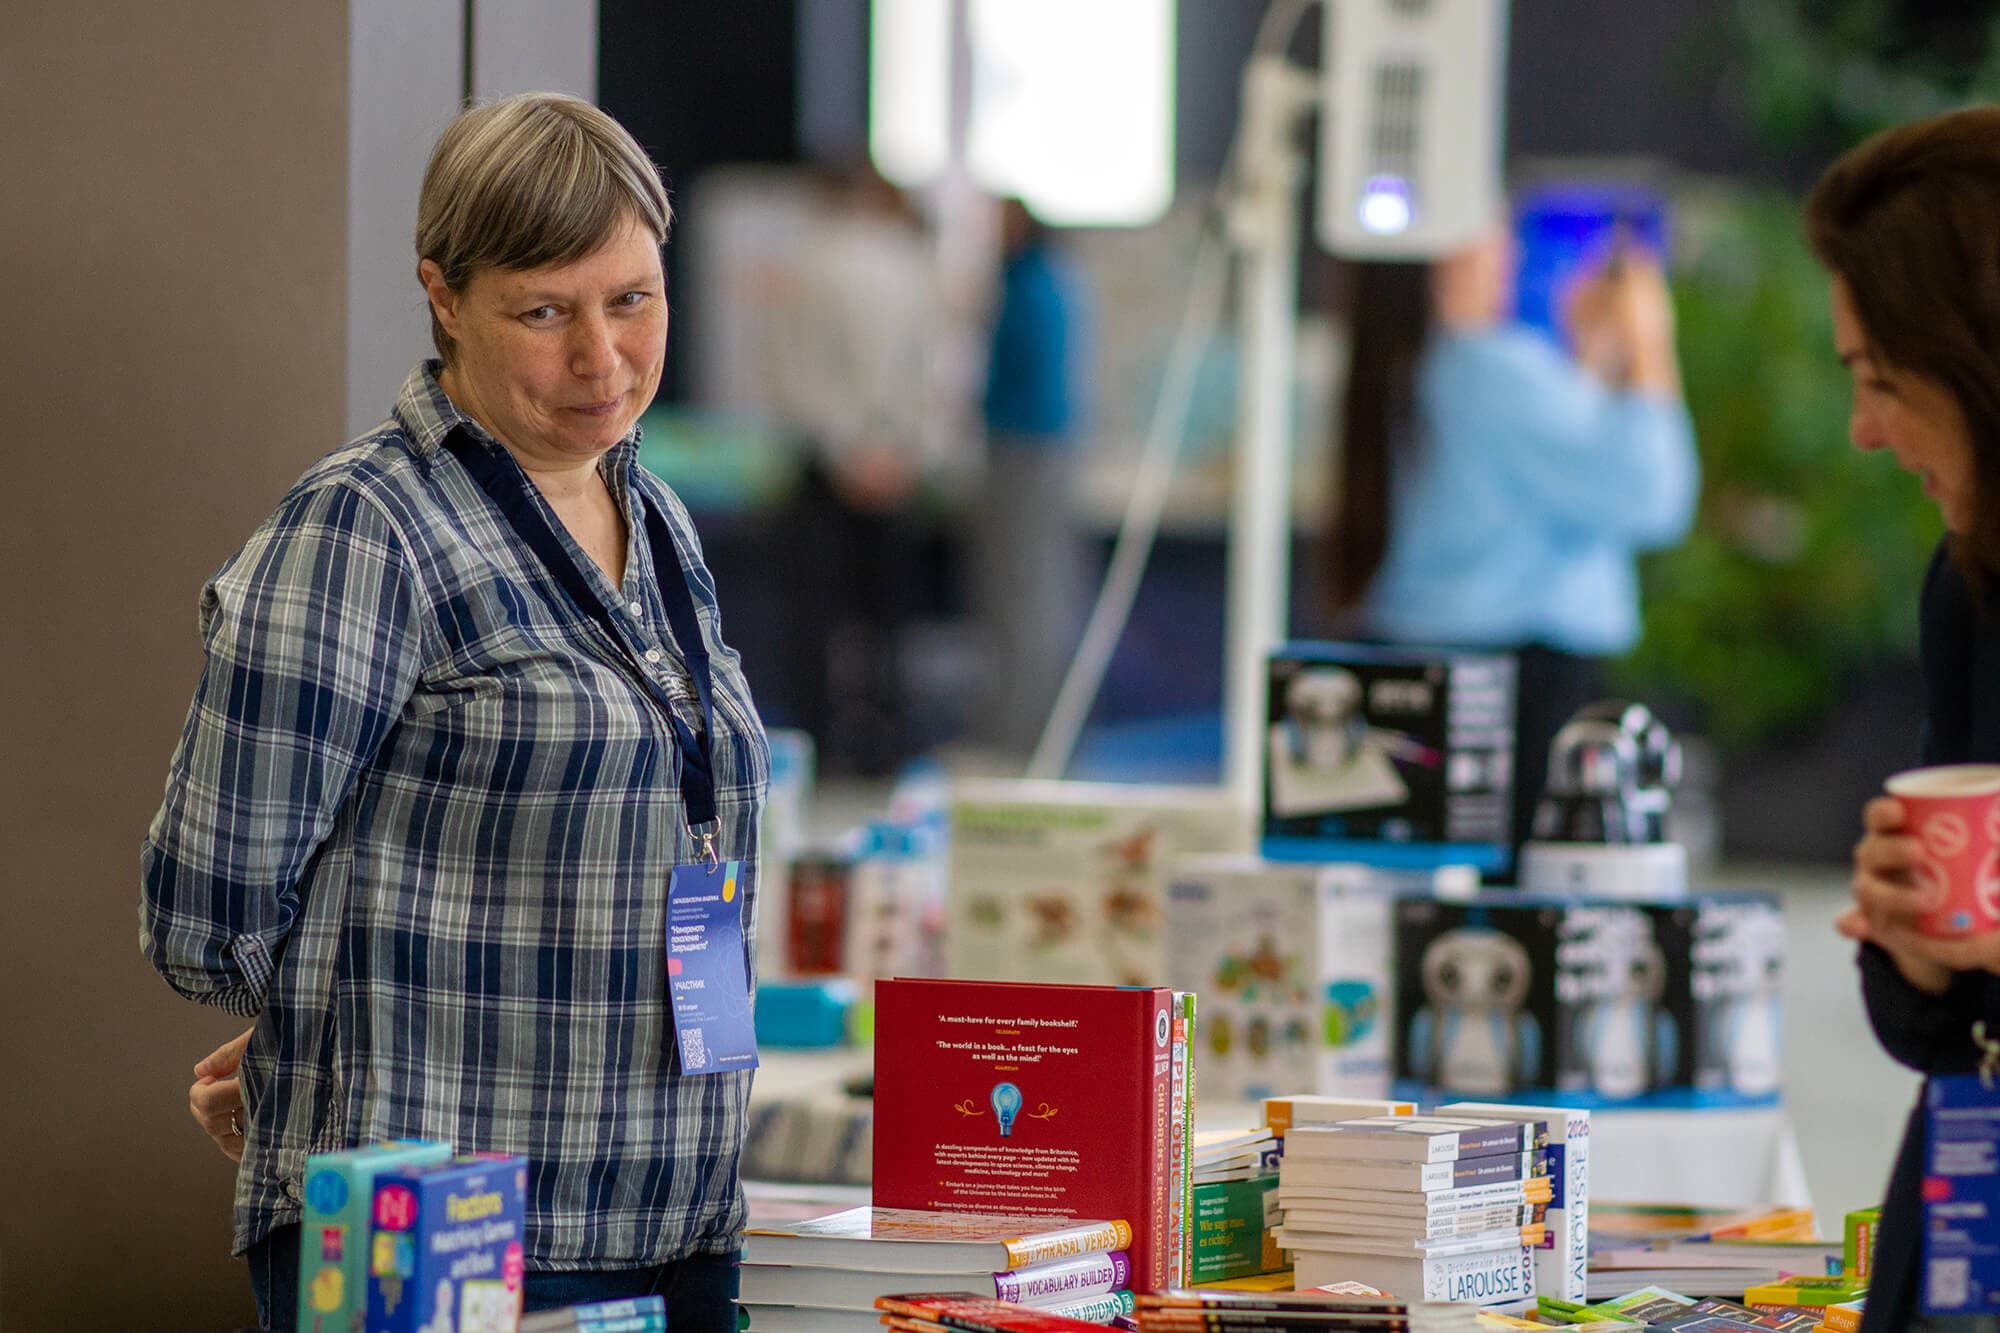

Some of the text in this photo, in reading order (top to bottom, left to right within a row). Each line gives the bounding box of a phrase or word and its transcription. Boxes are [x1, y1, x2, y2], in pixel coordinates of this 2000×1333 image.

[947, 1016, 983, 1024] must-have
[984, 1016, 996, 1024] for
[996, 1018, 1016, 1027] every
[1017, 1018, 1039, 1028] family
[1017, 1044, 1036, 1052] feast
[1037, 1045, 1048, 1053] for
[1169, 1060, 1183, 1281] PERIODIC TABLE
[1154, 1176, 1165, 1288] ENCYCLOPEDIA
[1574, 1146, 1587, 1299] LAROUSSE
[1035, 1239, 1081, 1261] PHRASAL
[1084, 1229, 1117, 1252] VERBS
[1027, 1273, 1079, 1296] VOCABULARY
[1081, 1268, 1113, 1288] BUILDER
[1448, 1266, 1518, 1301] LAROUSSE
[1084, 1298, 1120, 1321] IDIOMS
